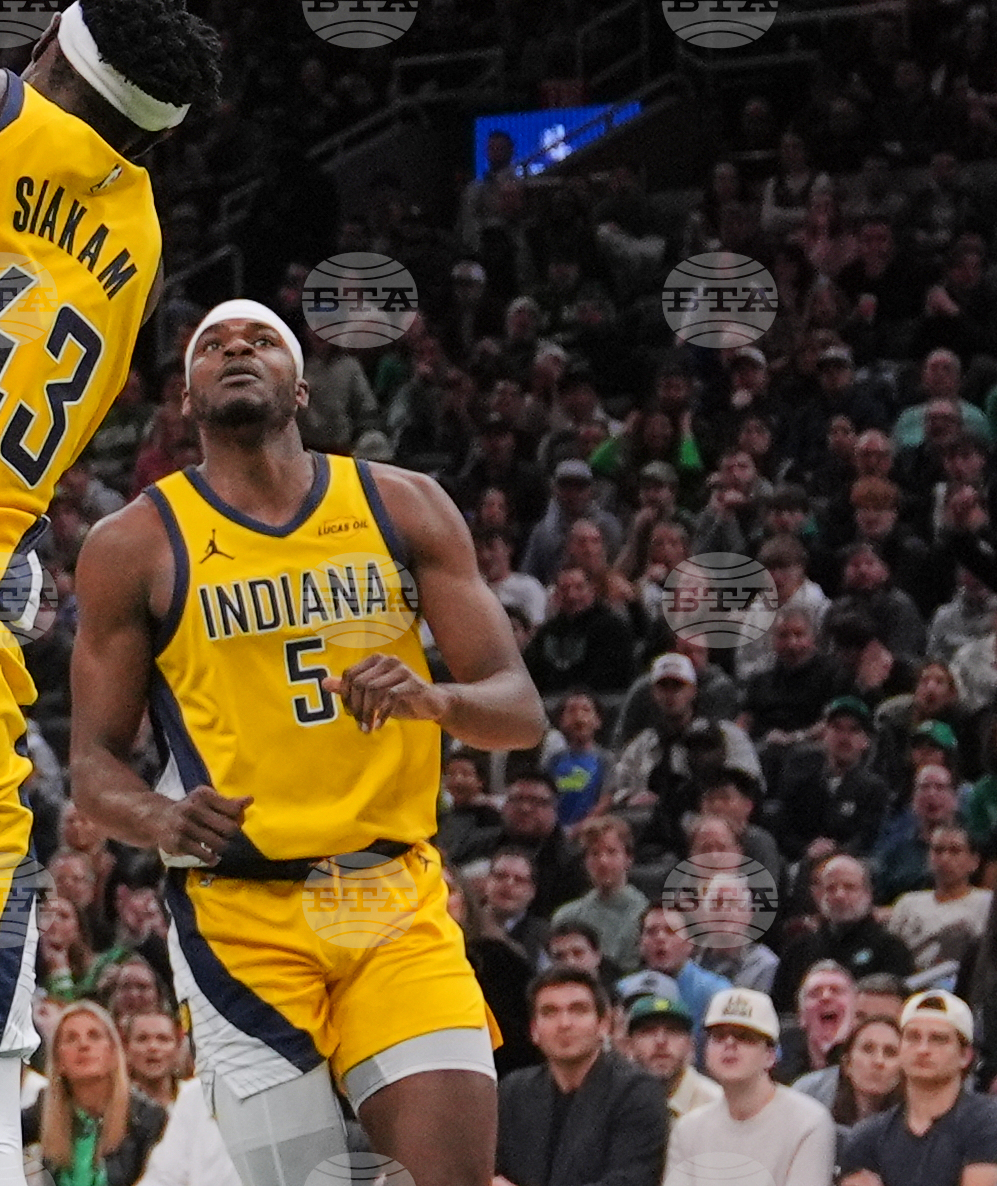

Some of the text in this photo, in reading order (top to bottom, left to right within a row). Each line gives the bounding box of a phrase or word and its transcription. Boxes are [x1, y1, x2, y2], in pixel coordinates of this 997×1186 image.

[13, 176, 138, 301] SIAKAM
[318, 520, 369, 536] LUCAS OIL
[198, 561, 388, 640] INDIANA
[284, 636, 338, 726] 5
